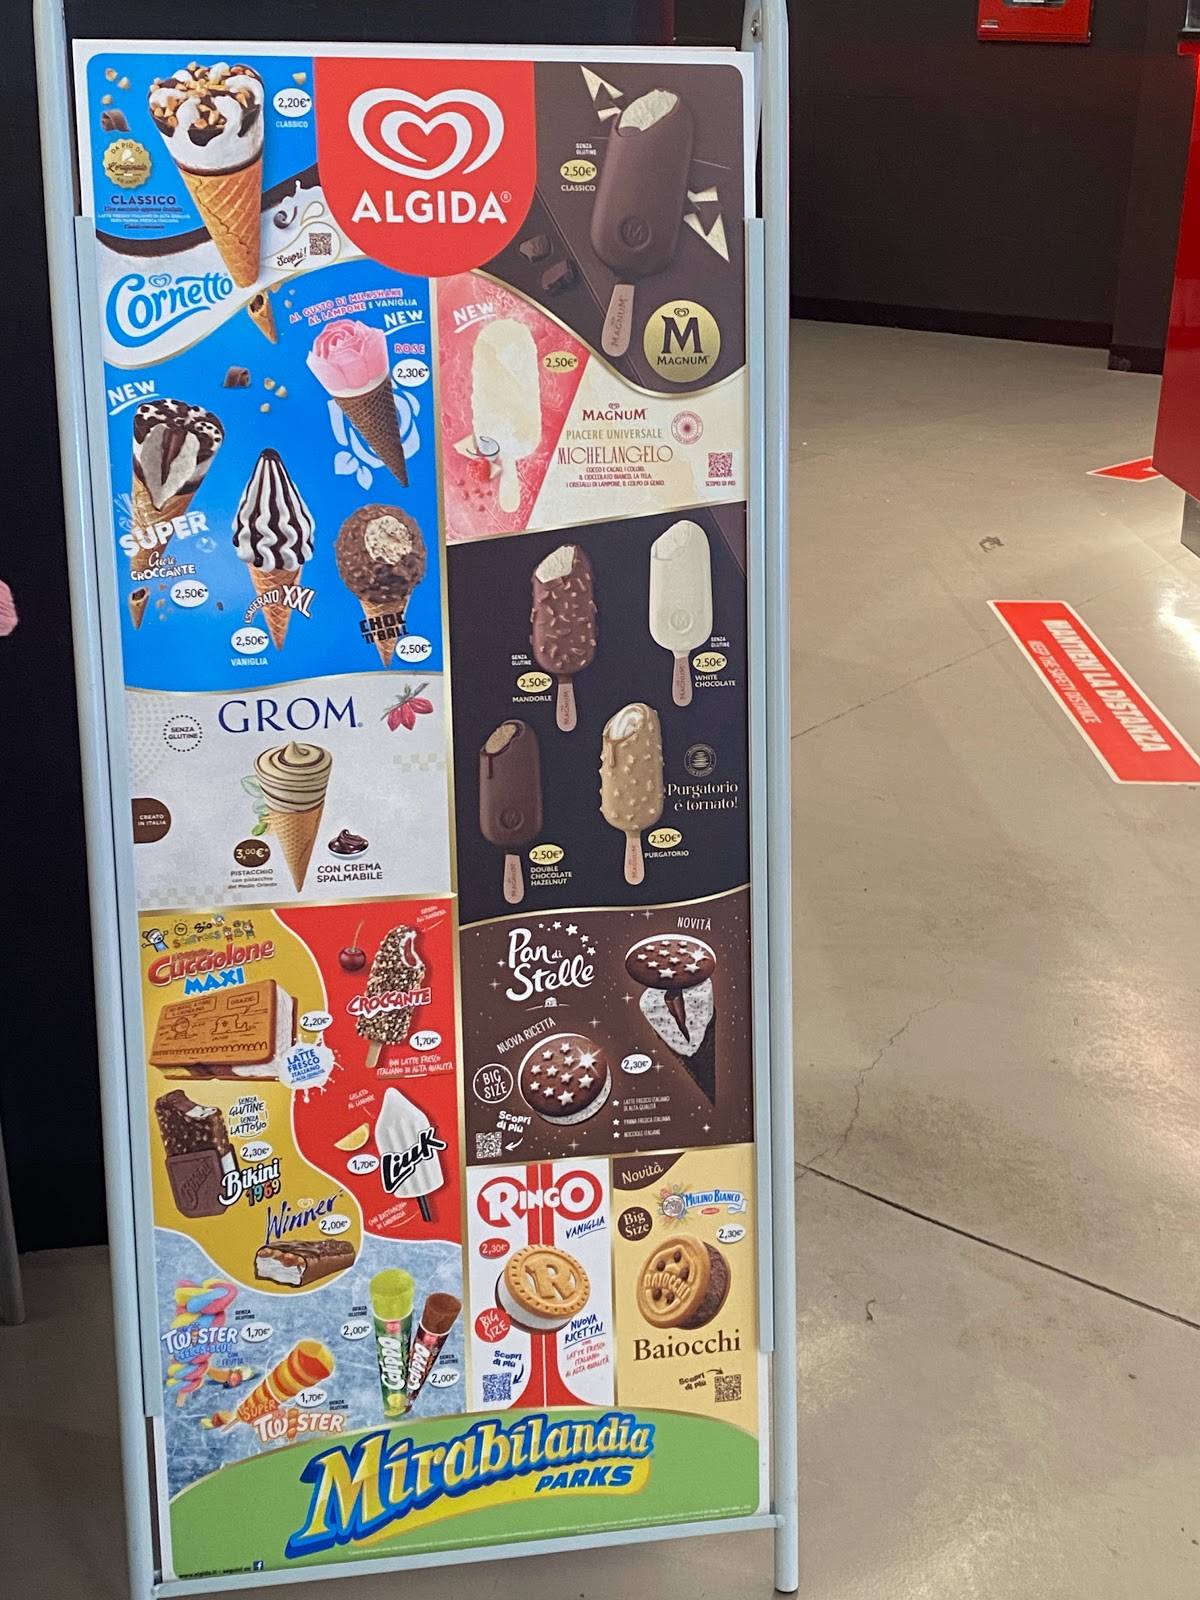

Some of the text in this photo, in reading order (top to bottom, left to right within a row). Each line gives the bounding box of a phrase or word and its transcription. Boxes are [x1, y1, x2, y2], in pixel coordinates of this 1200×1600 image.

[276, 120, 308, 128] CLASSICO
[561, 184, 595, 192] CLASSICO
[111, 195, 176, 205] CLASSICO
[106, 272, 233, 348] Cornetto
[303, 300, 334, 317] GUSTO
[321, 302, 366, 321] LAMPONE
[375, 299, 418, 309] VANIGLIA
[453, 303, 494, 326] NEW
[384, 310, 423, 329] NEW
[661, 315, 703, 354] M
[394, 343, 426, 355] ROSE
[657, 355, 708, 366] MAGNUM
[107, 380, 156, 406] NEW
[582, 408, 646, 421] MAGNUM
[566, 428, 662, 441] PIACERE UNIVERSALE
[557, 445, 673, 465] MICHELANGELO
[119, 511, 209, 557] SUPER
[130, 564, 197, 581] CROCCANTE
[282, 584, 315, 618] XXL
[359, 611, 407, 633] CHOC
[231, 657, 268, 666] VANIGLIA
[695, 680, 736, 688] CHOCOLATE
[1041, 619, 1172, 752] MANTIENI LA DISTANZA
[512, 694, 552, 703] MANDORLE
[218, 696, 358, 734] GROM
[667, 780, 738, 799] Purgatorio
[686, 796, 738, 811] tornato!
[644, 849, 689, 859] PURGATORIO
[230, 868, 274, 876] PISTACCHIO
[316, 872, 383, 883] SPALMABILE
[317, 863, 382, 874] CON CREMA
[530, 871, 572, 879] CHOCOLATE
[530, 878, 567, 886] HAZELNUT
[677, 916, 711, 931] NOVITÀ
[508, 928, 563, 969] Pan di
[147, 940, 275, 987] Cucciolone
[184, 967, 246, 996] MAXI
[505, 954, 596, 1001] Stelle
[347, 987, 431, 1016] CROCCANTE
[497, 1016, 556, 1055] NUOVA RICETTA
[287, 1049, 316, 1065] LATTE
[288, 1056, 320, 1073] FRESCO
[291, 1064, 321, 1078] ITALIANO
[483, 1069, 501, 1086] BIG
[484, 1083, 508, 1099] SIZE
[229, 1102, 264, 1116] GLUTINE
[498, 1110, 531, 1125] Scopri
[230, 1121, 266, 1135] LATTOSIO
[496, 1120, 507, 1130] di
[218, 1158, 282, 1206] Bikini
[621, 1161, 664, 1185] Novità
[245, 1179, 282, 1207] 1969
[685, 1189, 740, 1207] MULINO BIANCO
[265, 1194, 337, 1246] Winner
[565, 1215, 605, 1239] VANIGLIA
[623, 1211, 646, 1229] Big
[625, 1220, 650, 1238] Size
[644, 1273, 692, 1300] BAIOCCHI
[479, 1310, 499, 1328] BIG
[571, 1313, 597, 1331] NUOVA
[487, 1321, 509, 1342] SIZE
[633, 1329, 741, 1362] Baiocchi
[494, 1351, 522, 1360] Scopri
[678, 1373, 706, 1385] Scopri
[243, 1400, 276, 1421] SUPER
[296, 1413, 651, 1541] Mirabilandia
[535, 1464, 634, 1493] PARKS
